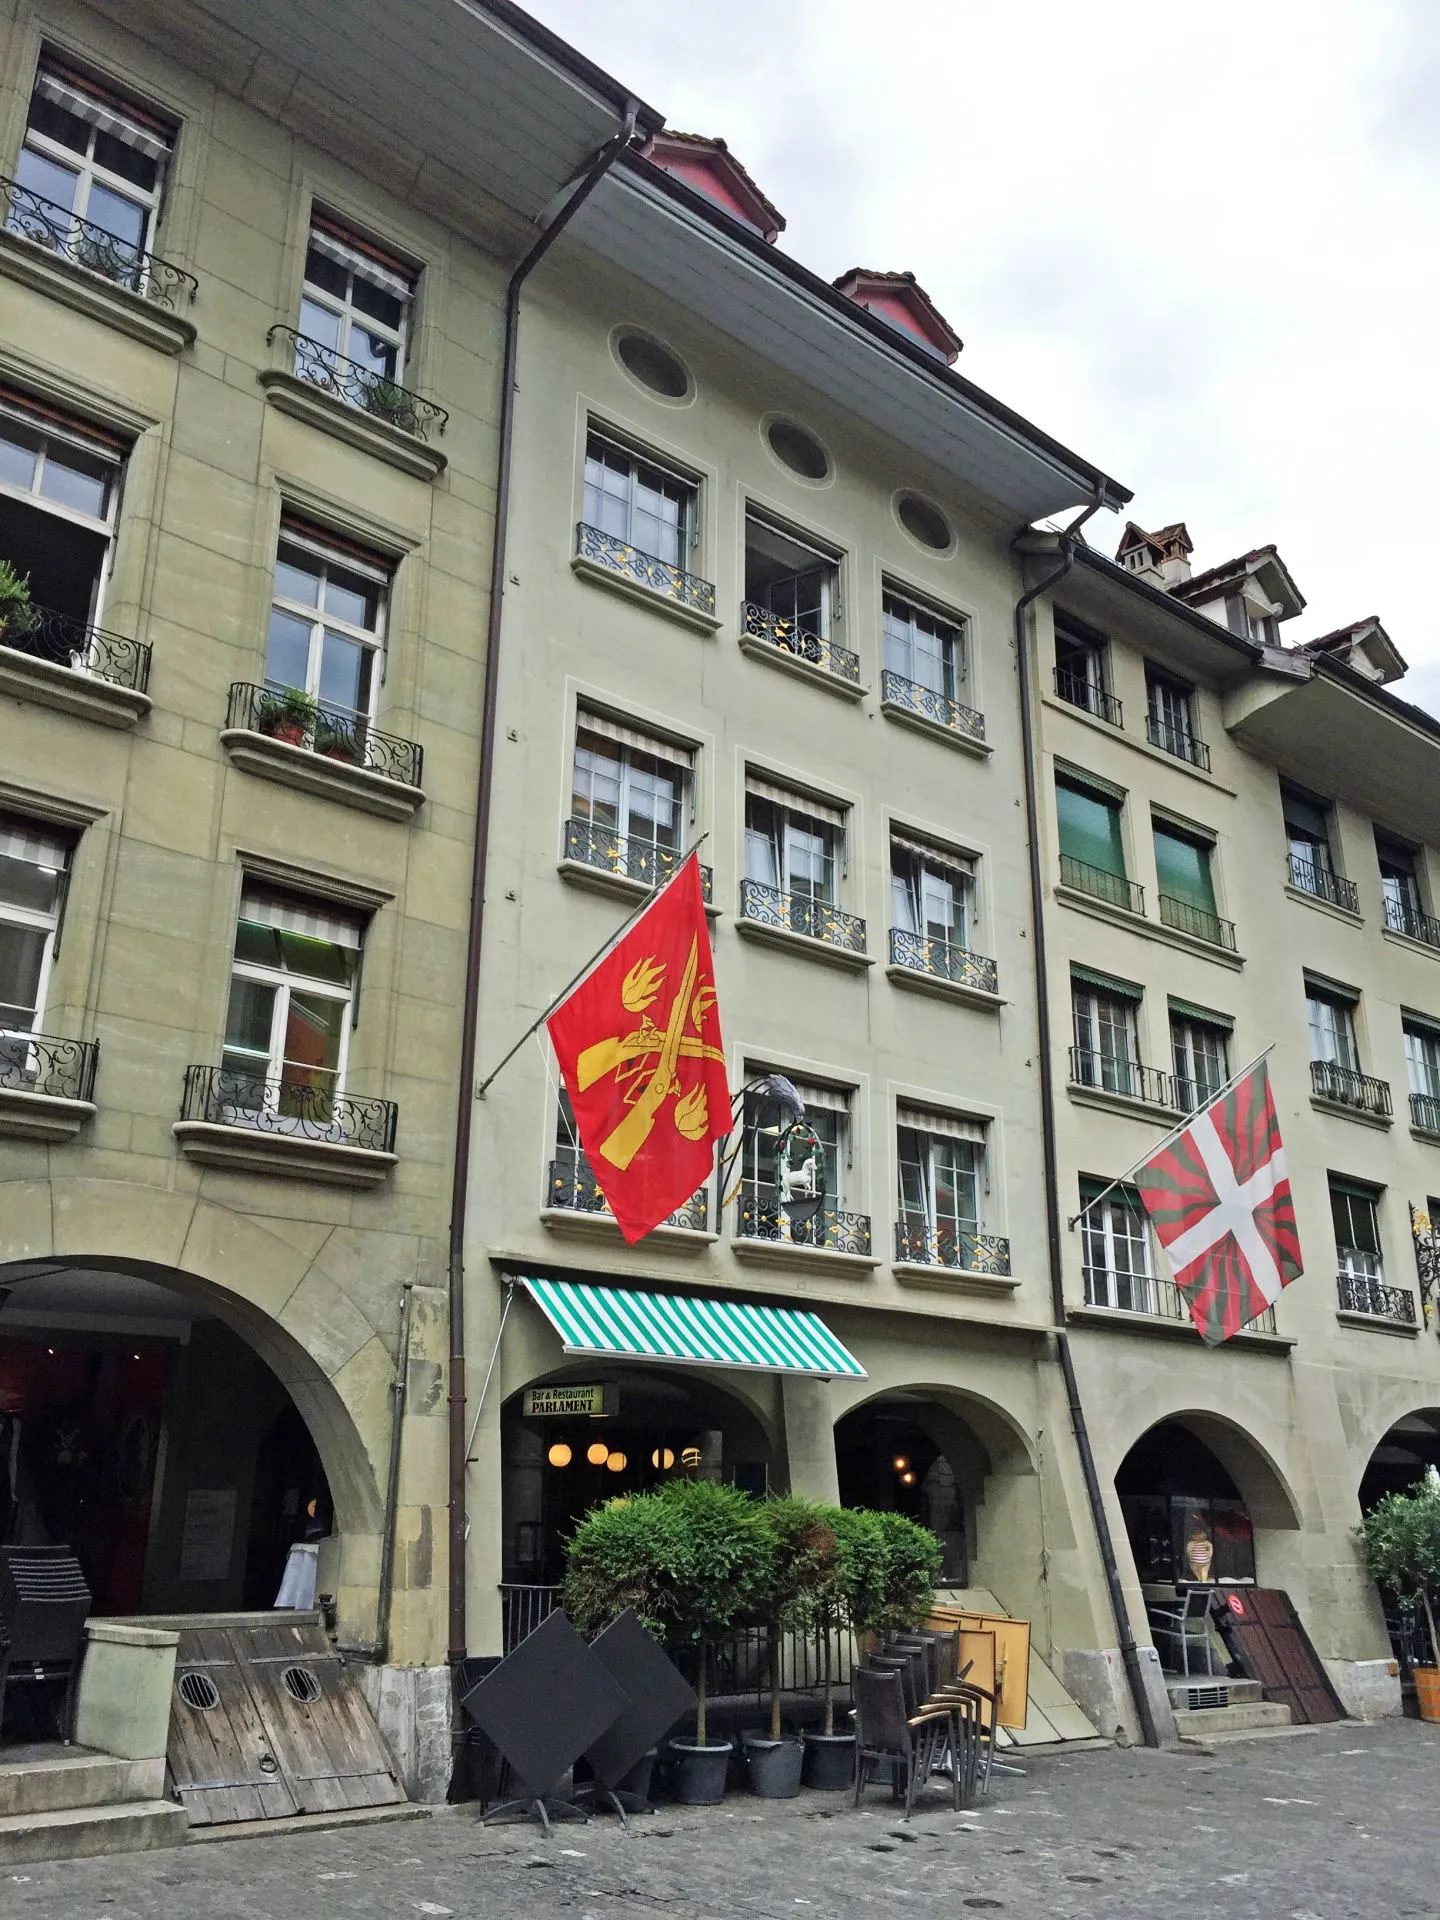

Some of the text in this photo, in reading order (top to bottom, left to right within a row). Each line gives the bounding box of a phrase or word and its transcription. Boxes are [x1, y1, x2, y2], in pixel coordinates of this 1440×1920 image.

[532, 1391, 544, 1401] Bar
[552, 1389, 594, 1399] Restaurant
[532, 1400, 593, 1413] PARLAMENT
